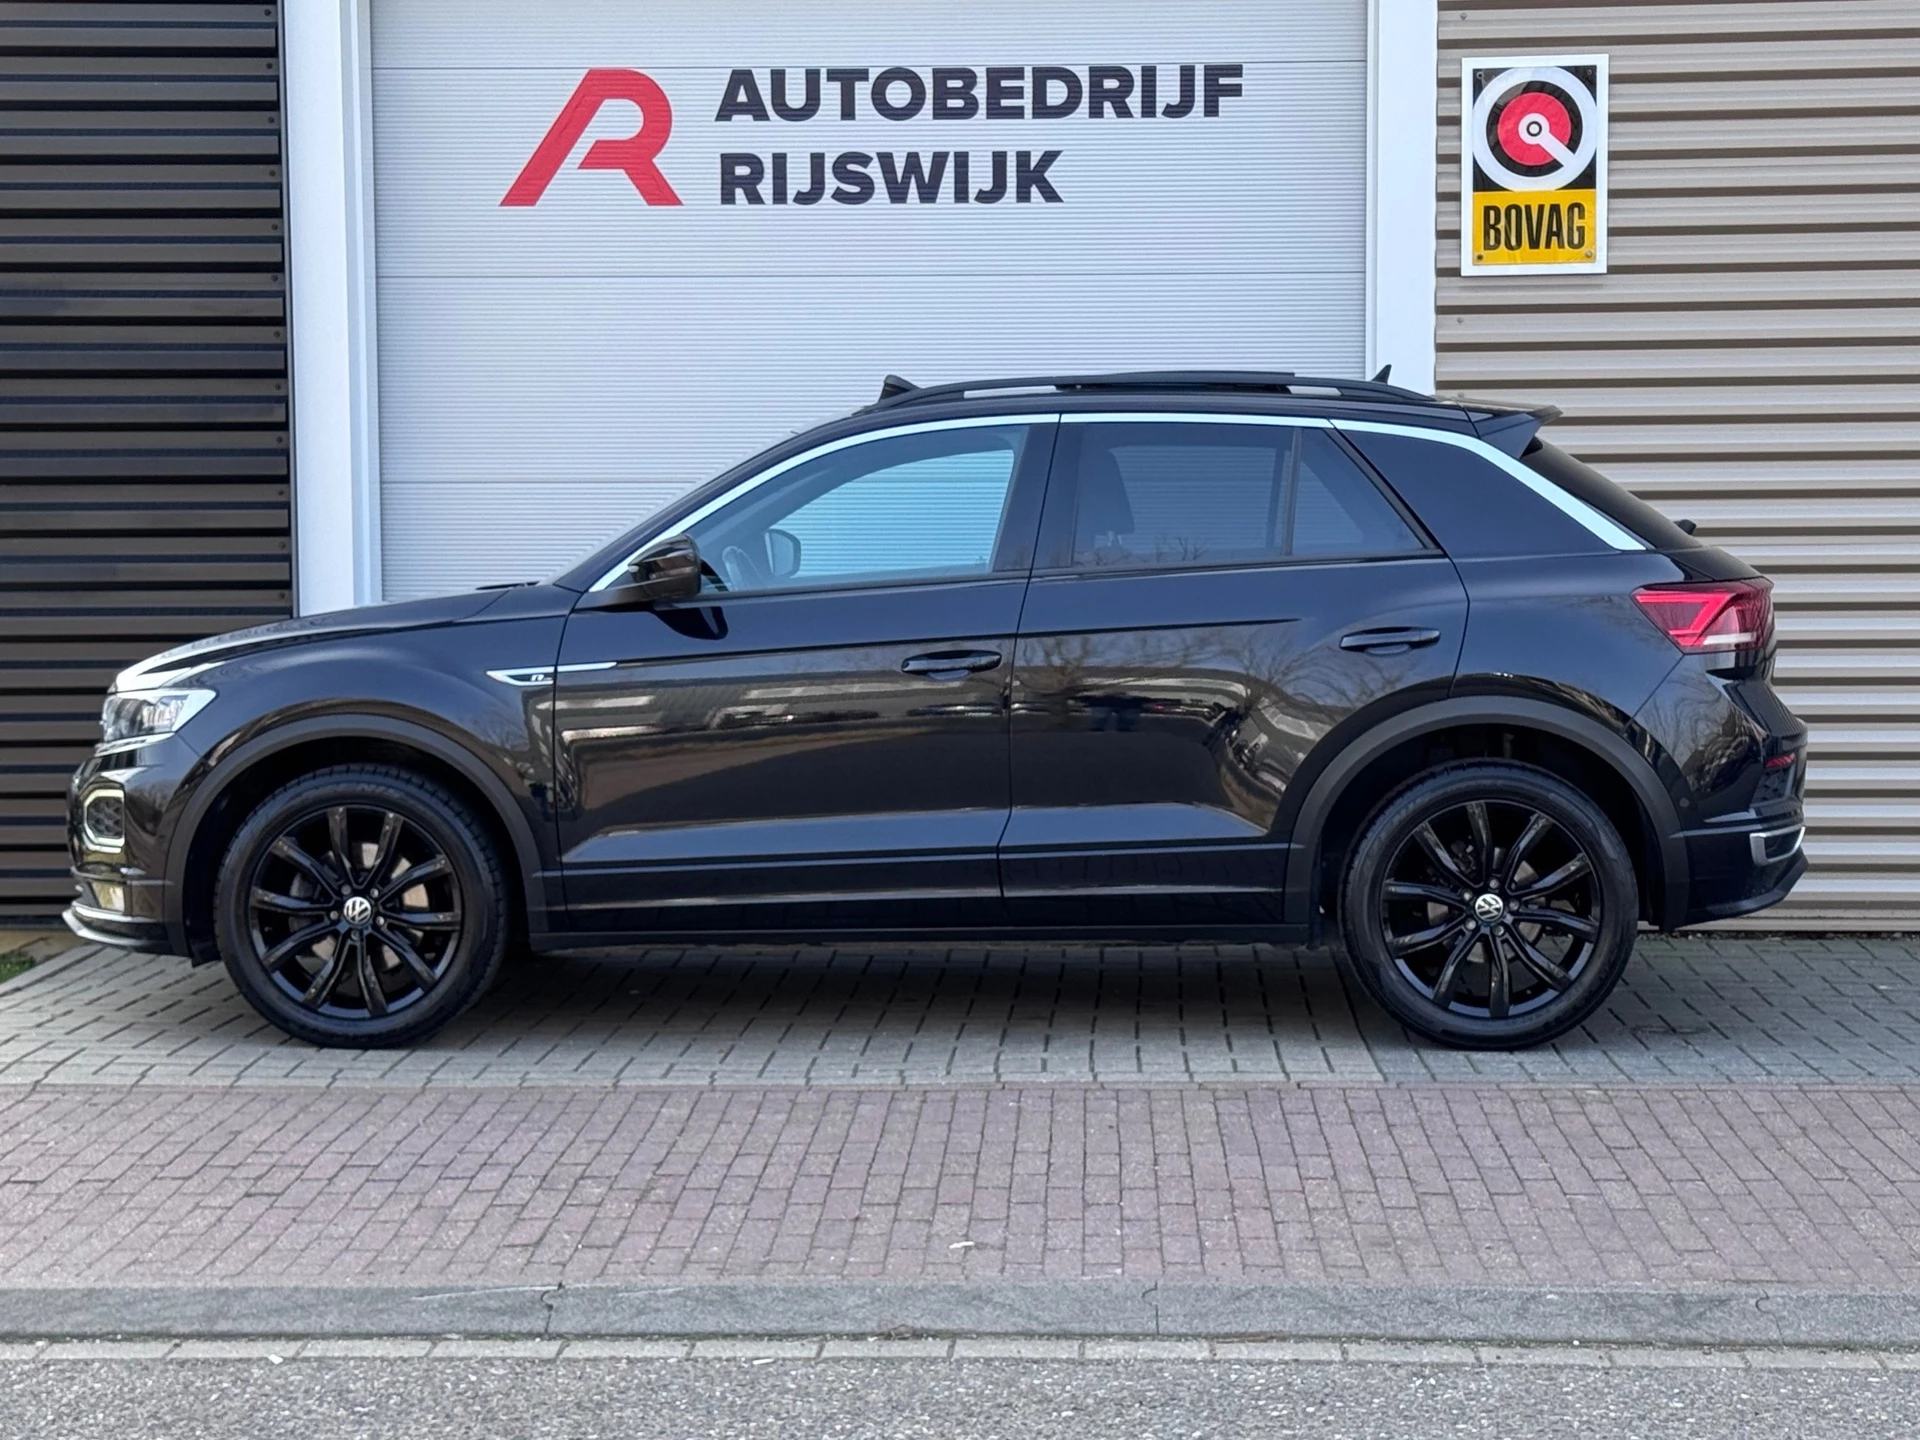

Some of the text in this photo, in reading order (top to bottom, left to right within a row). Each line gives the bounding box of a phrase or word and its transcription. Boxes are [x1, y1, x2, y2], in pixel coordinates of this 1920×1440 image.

[714, 64, 1243, 121] AUTOBEDRIJF
[720, 150, 1064, 205] RIJSWIJK
[1483, 202, 1586, 251] BOVAG
